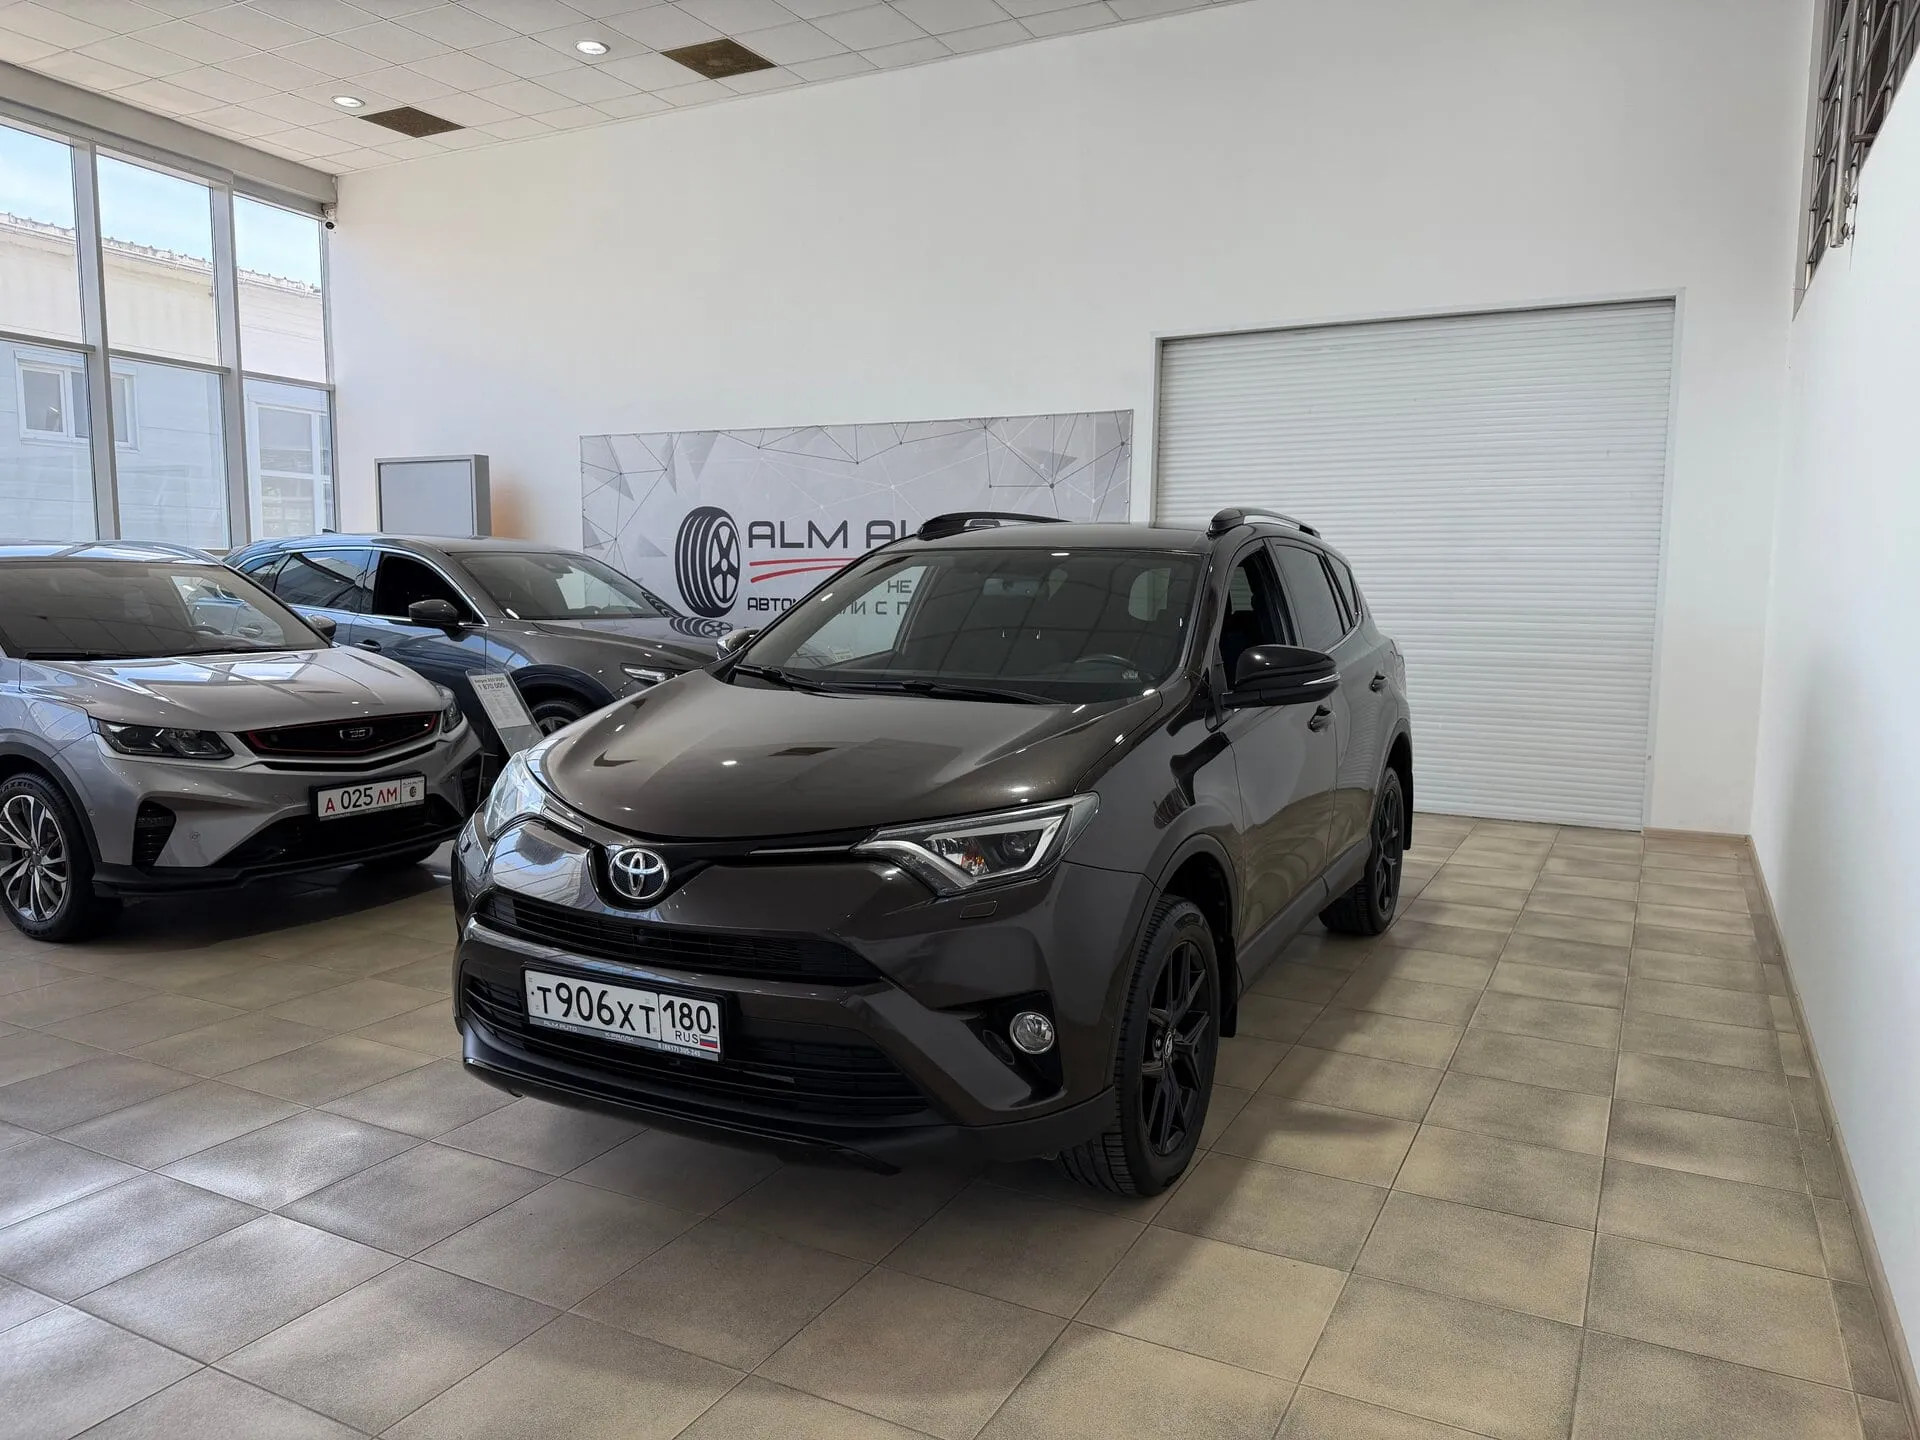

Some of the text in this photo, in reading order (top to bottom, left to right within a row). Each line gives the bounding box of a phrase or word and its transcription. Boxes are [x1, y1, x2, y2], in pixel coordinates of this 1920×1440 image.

[748, 519, 848, 549] ALM
[747, 597, 797, 612] АВТО
[340, 786, 374, 810] 025
[662, 999, 712, 1034] 180
[674, 1030, 699, 1044] RUS
